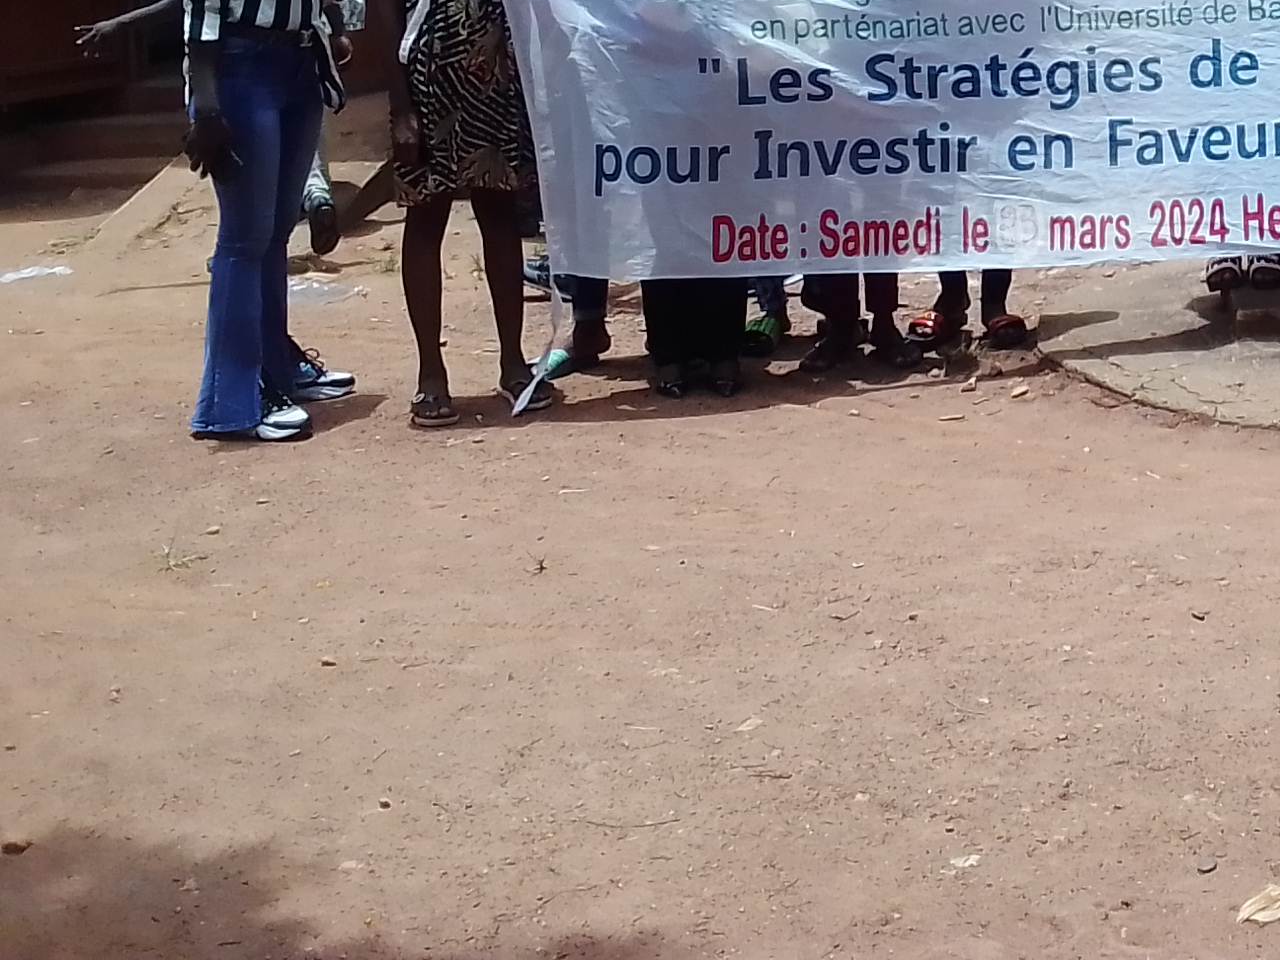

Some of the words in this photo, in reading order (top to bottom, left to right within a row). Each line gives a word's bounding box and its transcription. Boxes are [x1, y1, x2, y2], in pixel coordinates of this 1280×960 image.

[750, 19, 787, 40] en
[957, 12, 1026, 37] avec
[1039, 0, 1194, 33] l'Université
[1202, 0, 1238, 24] de
[865, 47, 1164, 111] Stratégies
[1189, 39, 1260, 88] de
[594, 142, 732, 197] pour
[753, 122, 978, 180] Investir
[1006, 132, 1074, 171] en
[819, 206, 941, 257] Samedi
[962, 205, 988, 253] le
[1049, 214, 1131, 250] mars
[1148, 198, 1229, 247] 2024
